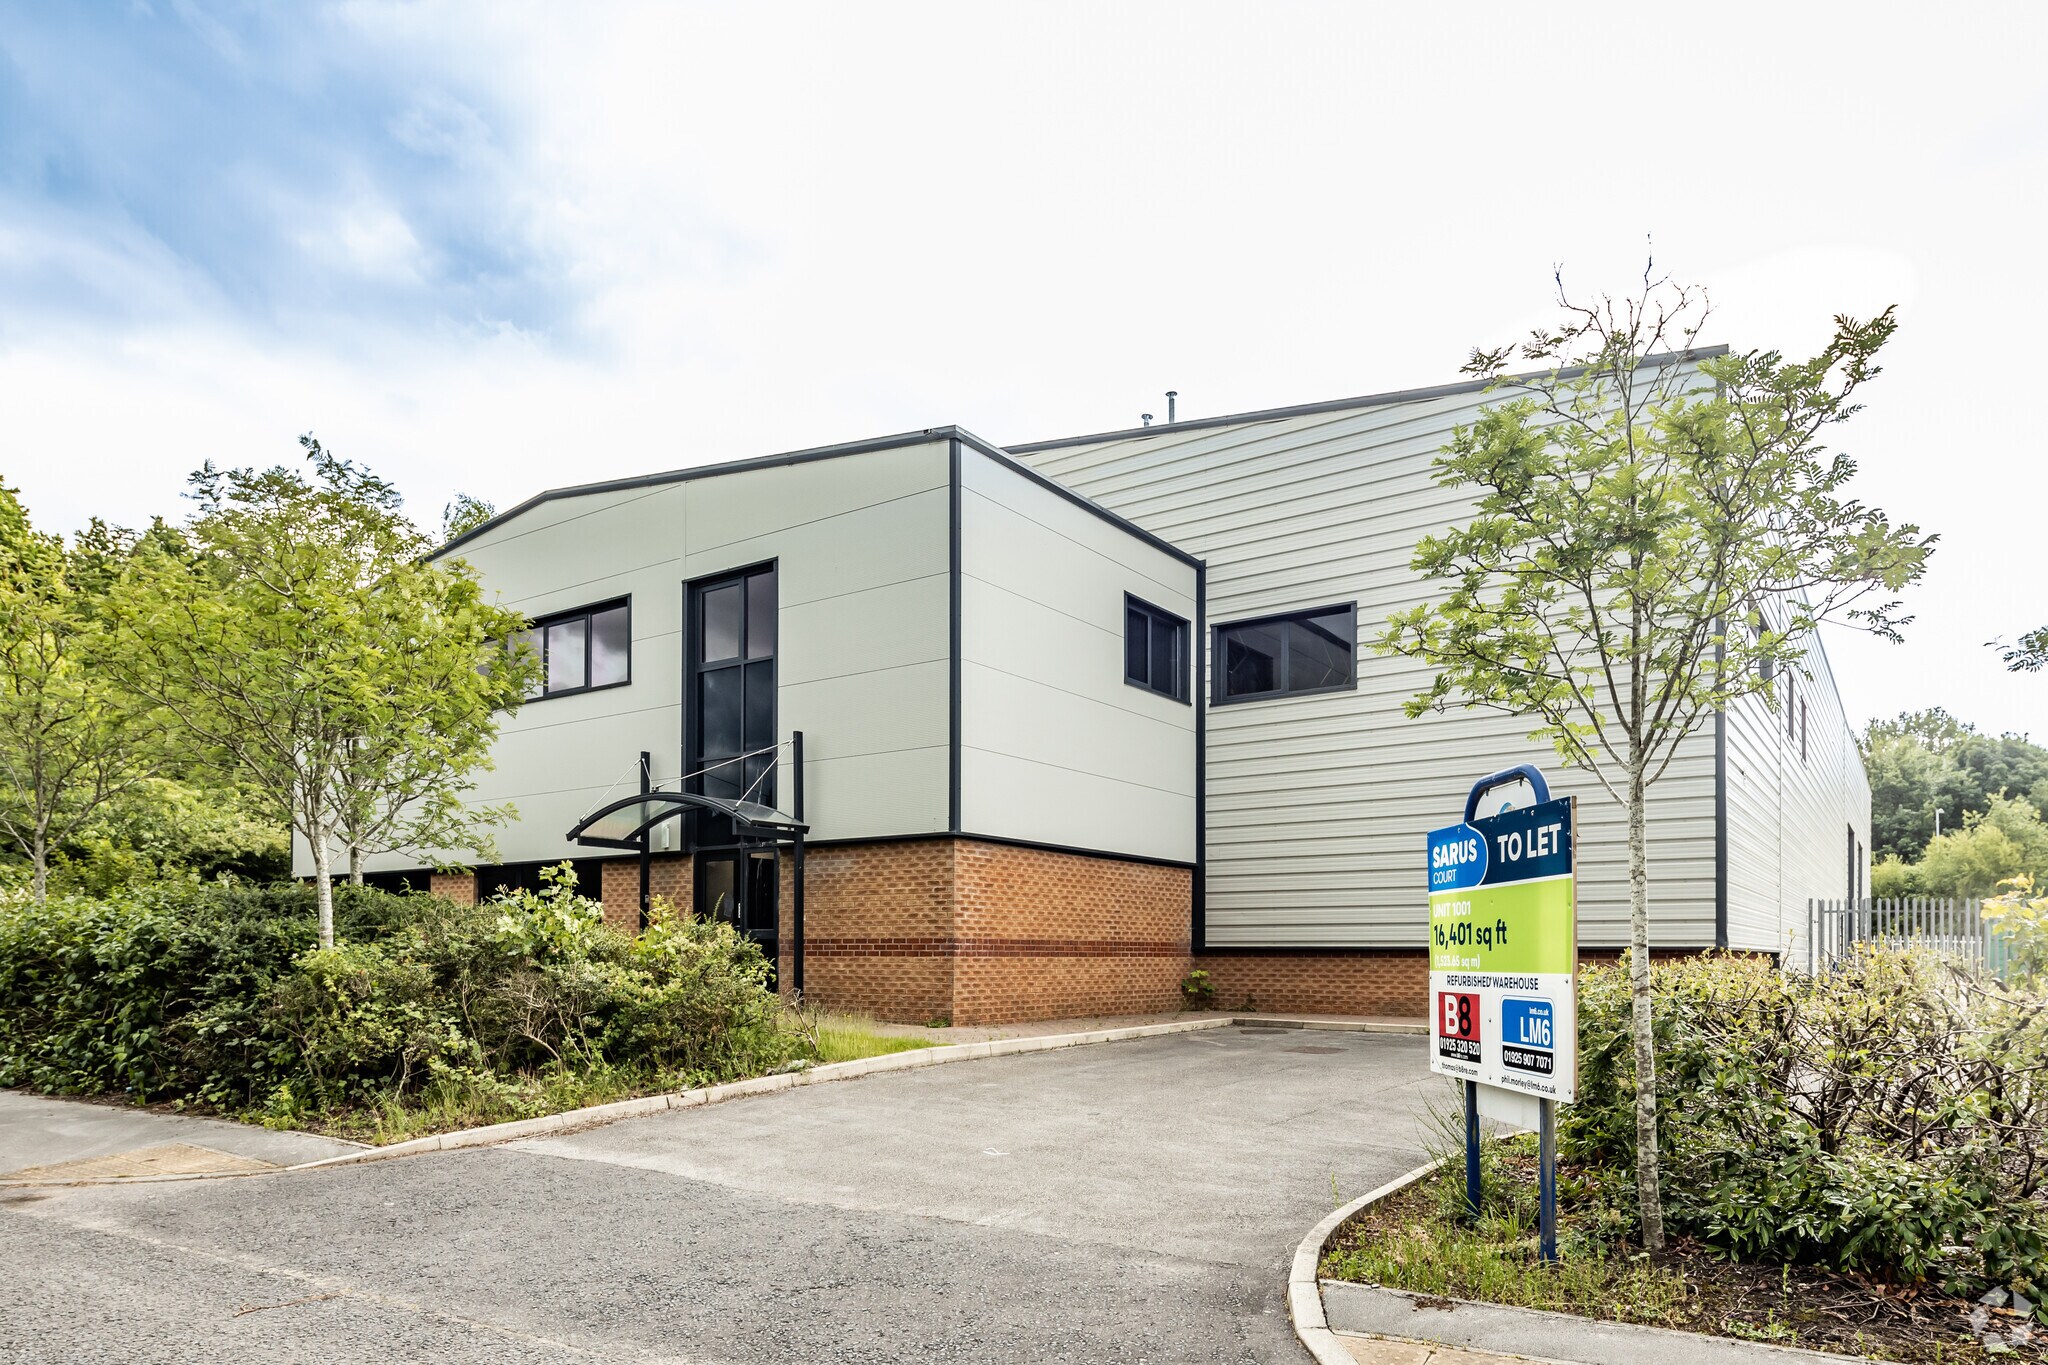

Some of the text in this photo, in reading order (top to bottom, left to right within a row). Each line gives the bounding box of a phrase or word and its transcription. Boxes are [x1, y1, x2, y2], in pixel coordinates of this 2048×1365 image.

[1432, 838, 1478, 868] SARUS
[1497, 823, 1562, 863] TO LET
[1433, 869, 1457, 885] COURT
[1433, 901, 1471, 918] UNIT 1001
[1434, 919, 1507, 952] 16,401 sq ft
[1461, 957, 1470, 971] sq
[1470, 953, 1481, 969] m)
[1447, 975, 1539, 990] REFURBISHED WAREHOUSE
[1444, 994, 1472, 1037] B8
[1520, 1016, 1551, 1046] LM6
[1439, 1036, 1456, 1052] 01925
[1456, 1039, 1468, 1054] 320
[1468, 1041, 1480, 1056] 520
[1503, 1049, 1552, 1070] 01925 907 7071
[1501, 1074, 1557, 1095] phil.morley@lm6.co.uk
